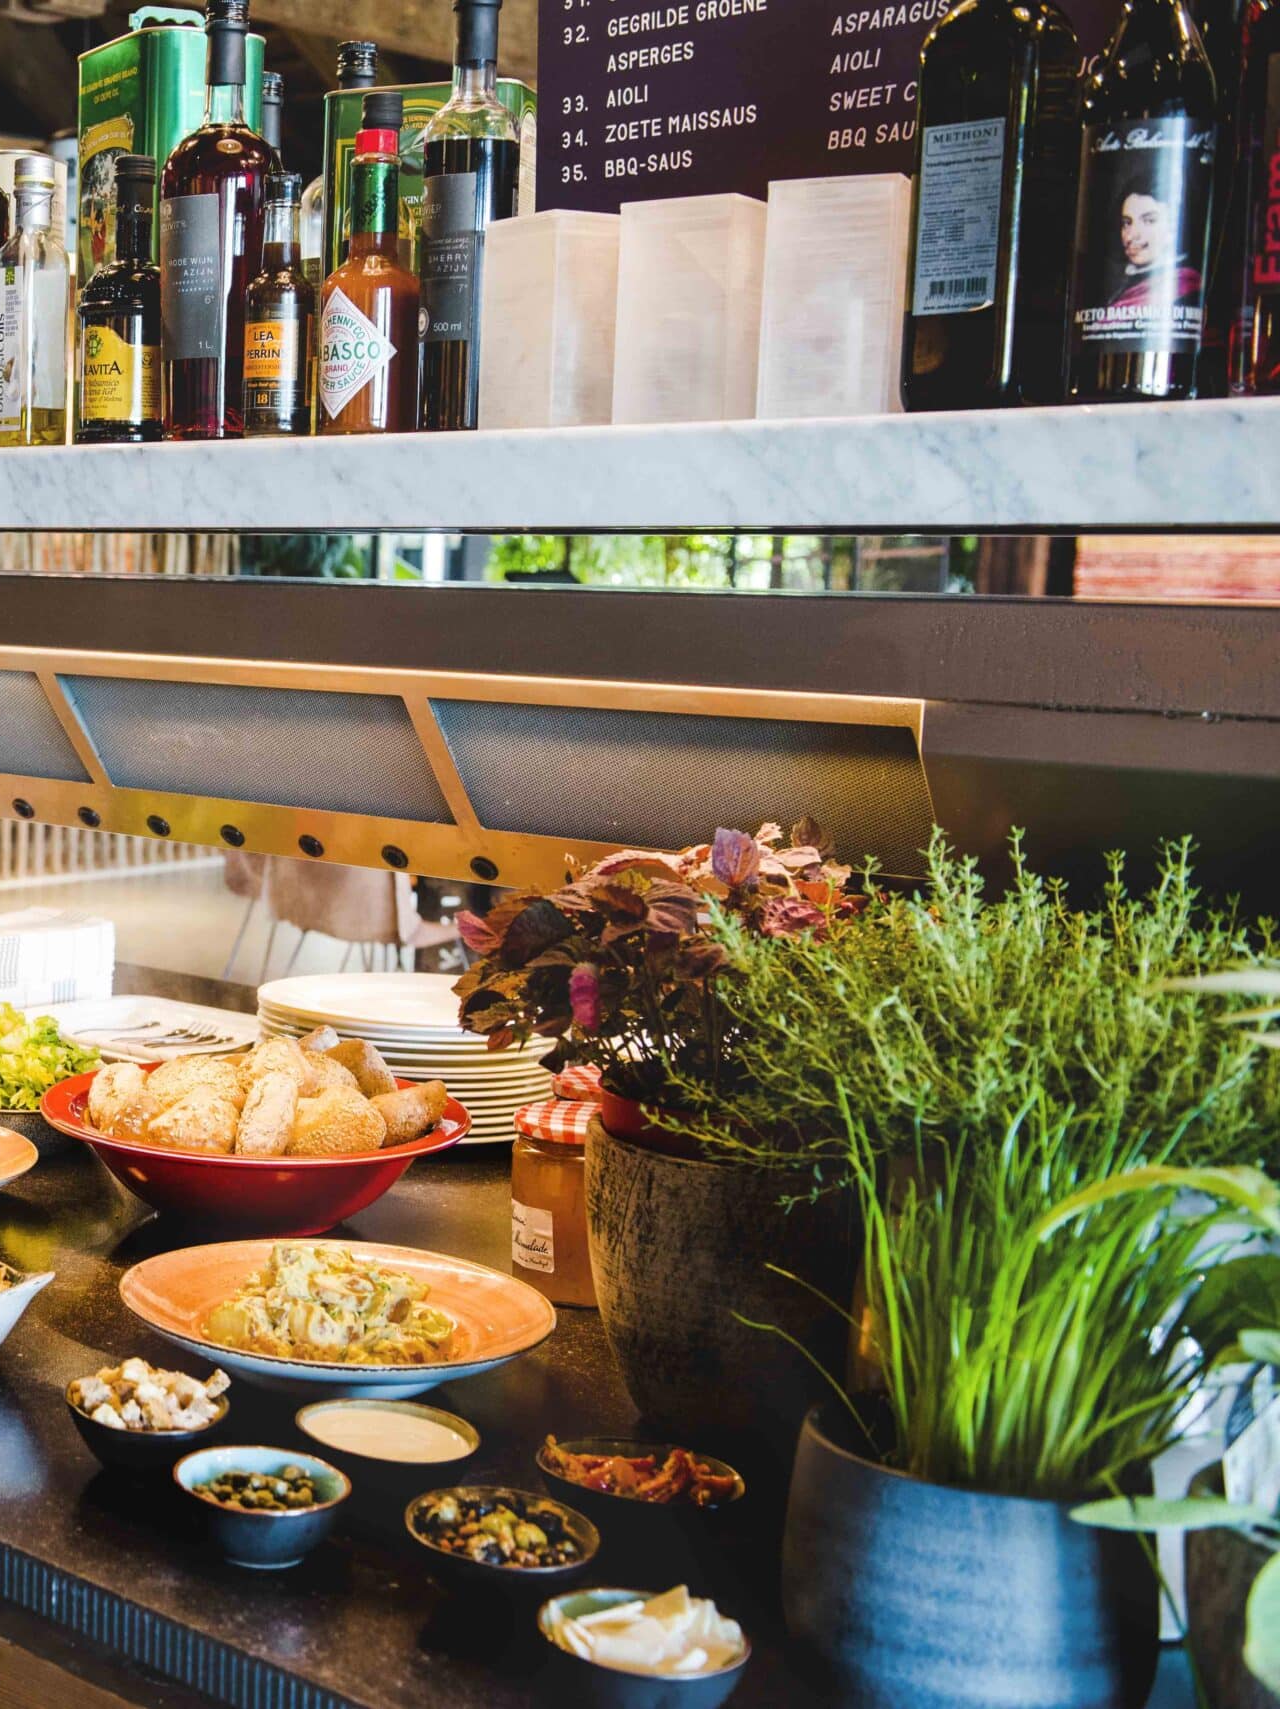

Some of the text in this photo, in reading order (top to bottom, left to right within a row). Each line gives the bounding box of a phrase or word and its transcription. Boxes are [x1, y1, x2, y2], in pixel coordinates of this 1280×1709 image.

[563, 0, 769, 45] 32. GEGRILDE GROENE
[831, 0, 951, 37] ASPARAGUS
[607, 41, 695, 73] ASPERGES
[830, 47, 881, 75] AIOLI
[562, 84, 649, 115] 33. AIOLI
[829, 84, 897, 112] SWEET
[562, 104, 758, 149] 34. ZOETE MAISSAUS
[827, 120, 916, 150] BBQ SAU
[933, 127, 999, 144] METHONI
[561, 150, 693, 183] 35. BBQ-SAUS
[404, 195, 420, 205] GIN
[189, 256, 214, 265] WIJN
[429, 254, 469, 264] SHERRY
[437, 264, 469, 273] AZIJN
[183, 268, 215, 277] AZIJN
[1074, 308, 1106, 323] ACETO
[433, 320, 462, 332] 500 ml
[253, 331, 275, 342] LEA
[323, 340, 381, 362] BASCO
[83, 360, 123, 377] LAVITA
[336, 362, 366, 389] SAUCE
[256, 393, 269, 404] 18
